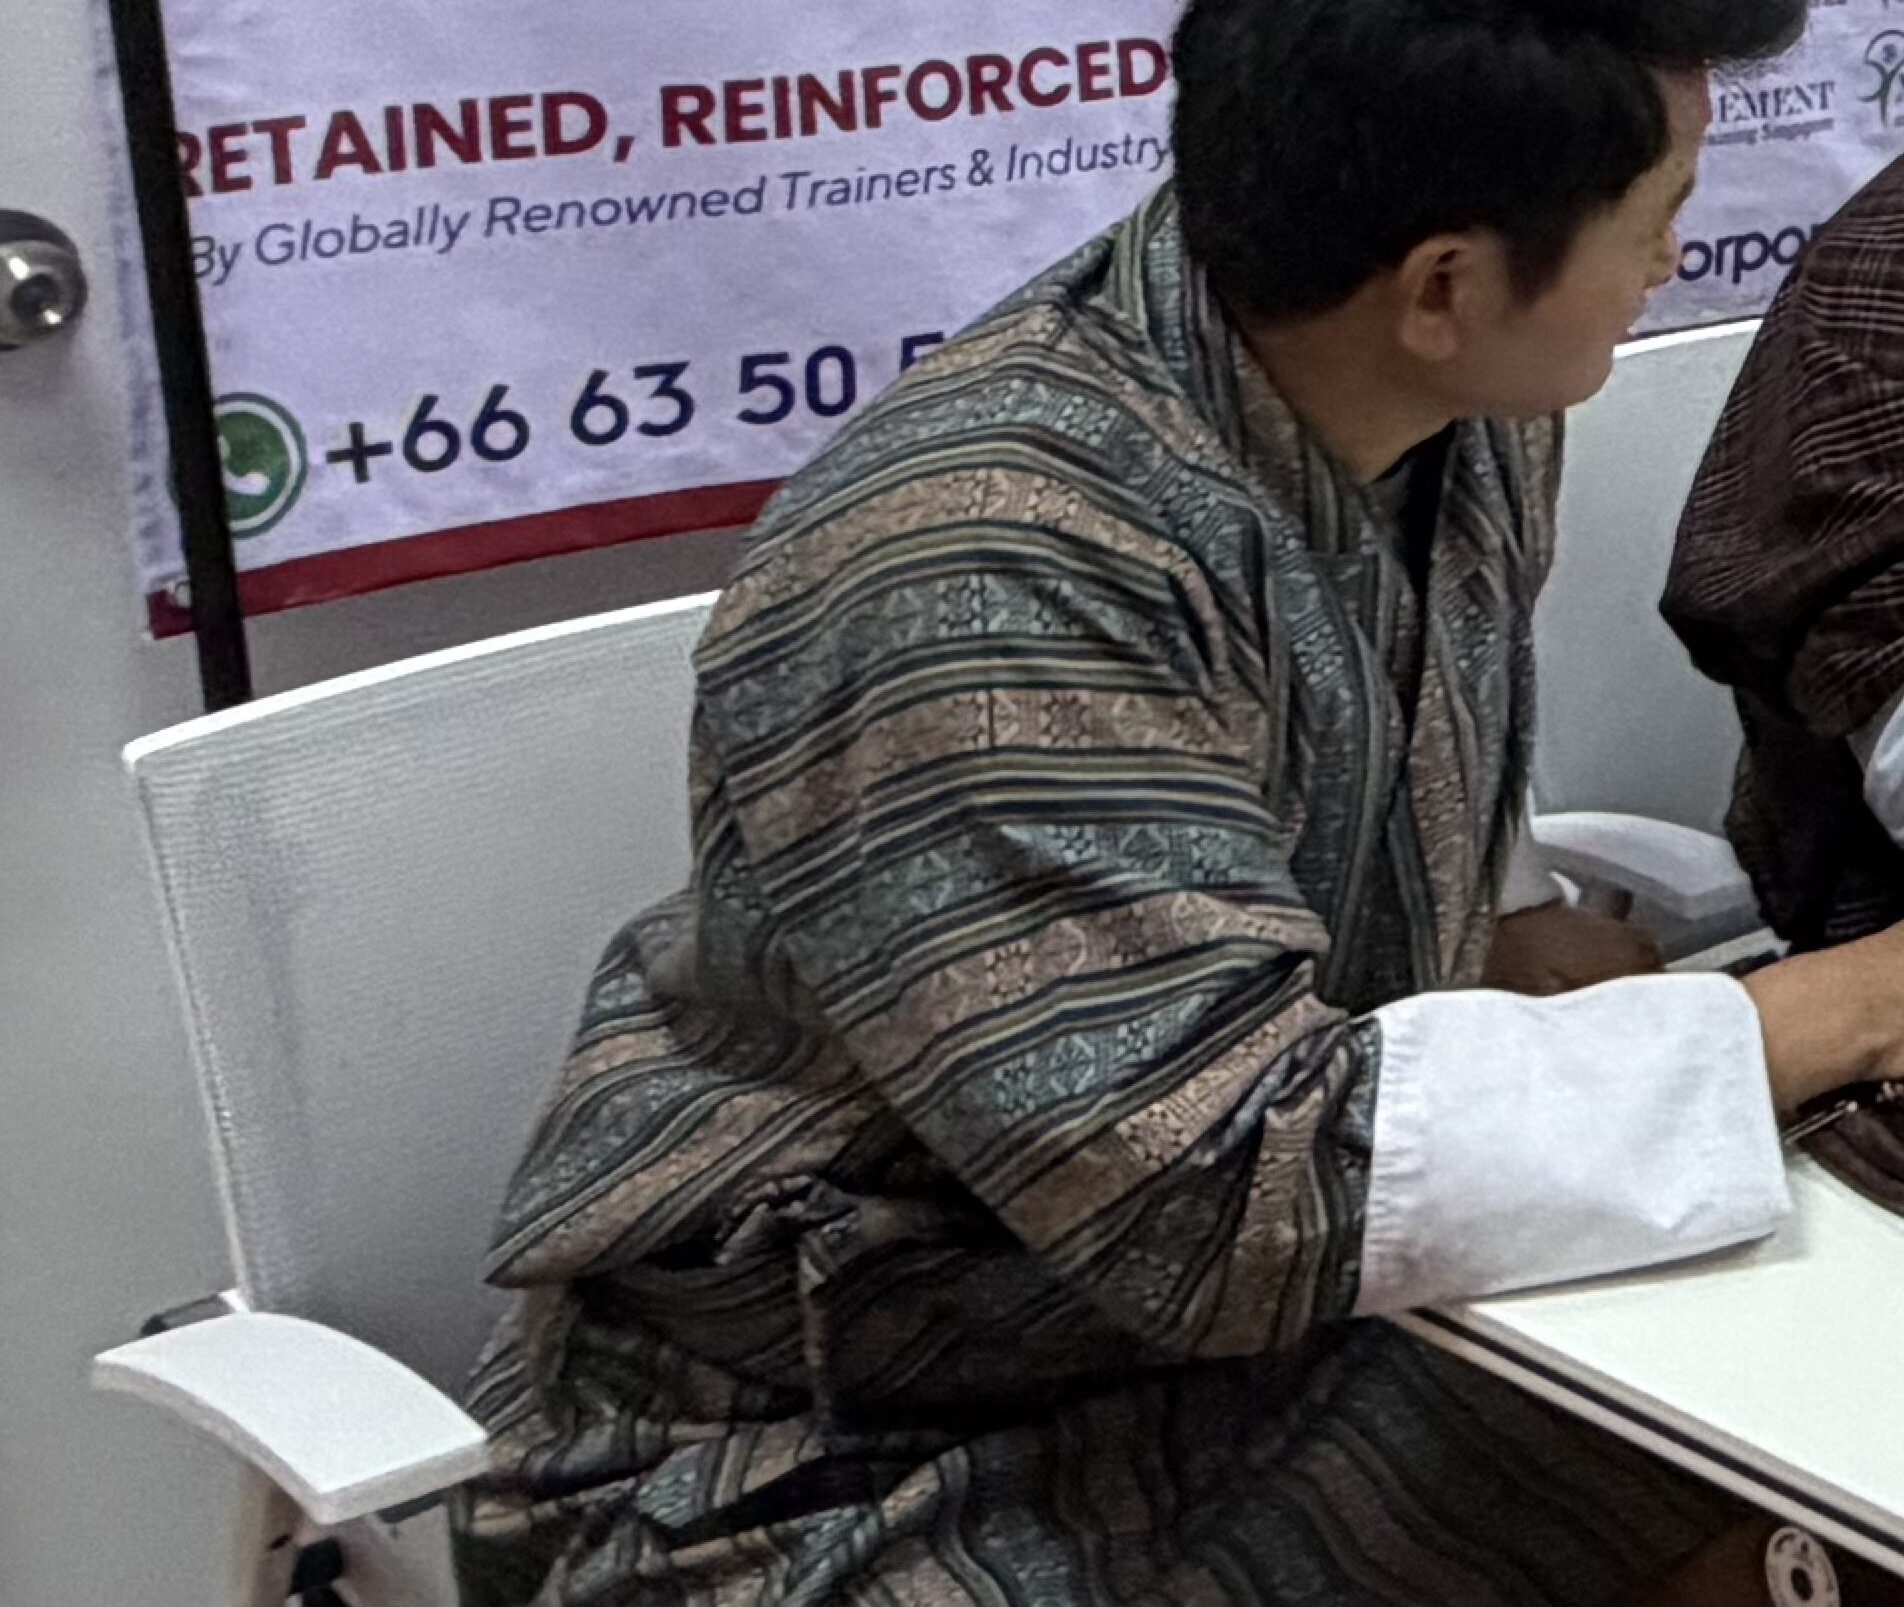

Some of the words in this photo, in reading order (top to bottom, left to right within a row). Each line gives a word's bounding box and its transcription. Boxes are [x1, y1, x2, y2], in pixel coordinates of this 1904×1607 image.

[660, 37, 1168, 149] REINFORCED
[190, 236, 241, 285] By
[255, 204, 471, 267] Globally
[484, 175, 767, 238] Renowned
[779, 164, 956, 211] Trainers
[967, 149, 995, 186] &
[1005, 133, 1169, 182] Industry
[1677, 223, 1822, 284] orpo
[326, 384, 530, 483] +66
[570, 361, 695, 446] 63
[737, 346, 856, 425] 50
